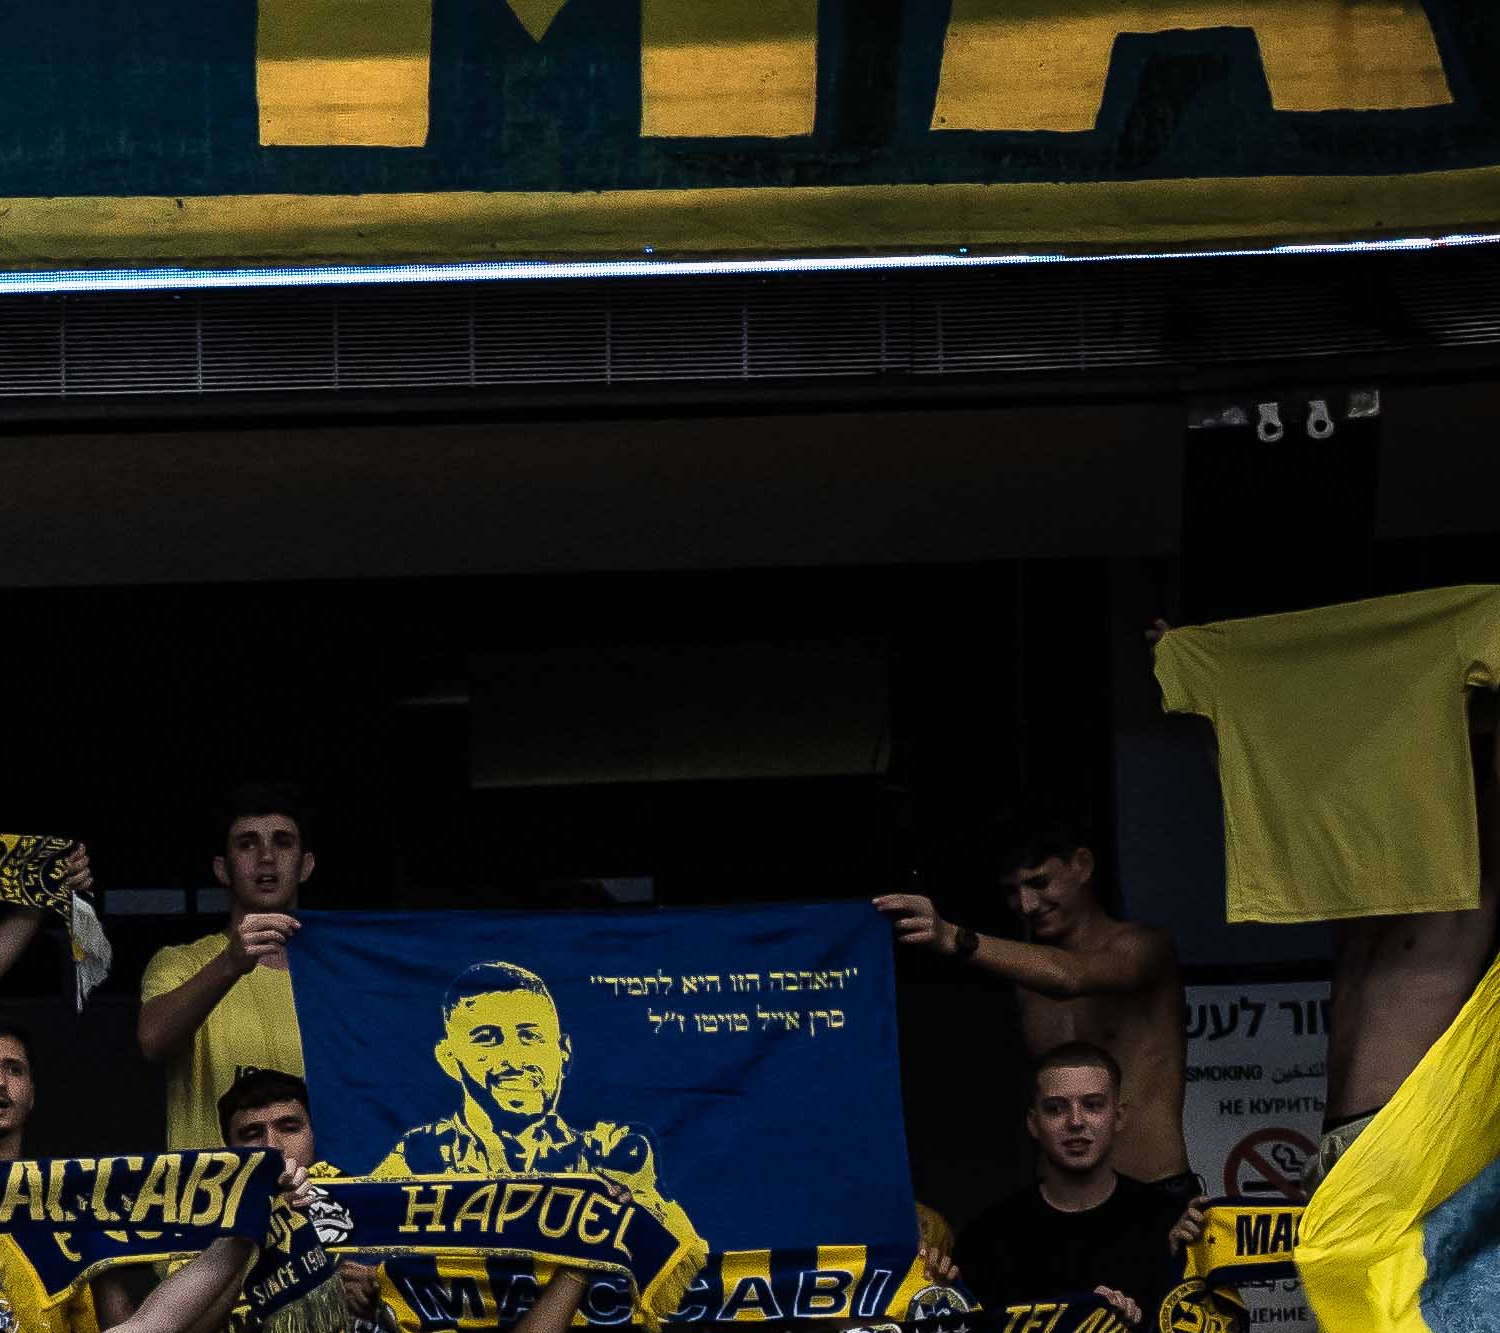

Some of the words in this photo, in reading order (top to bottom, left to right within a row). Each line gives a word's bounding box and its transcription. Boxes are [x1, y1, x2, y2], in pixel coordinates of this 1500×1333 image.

[1185, 1065, 1263, 1083] SMOKING
[1219, 1098, 1245, 1116] НЕ
[398, 1182, 636, 1262] HAPOEL
